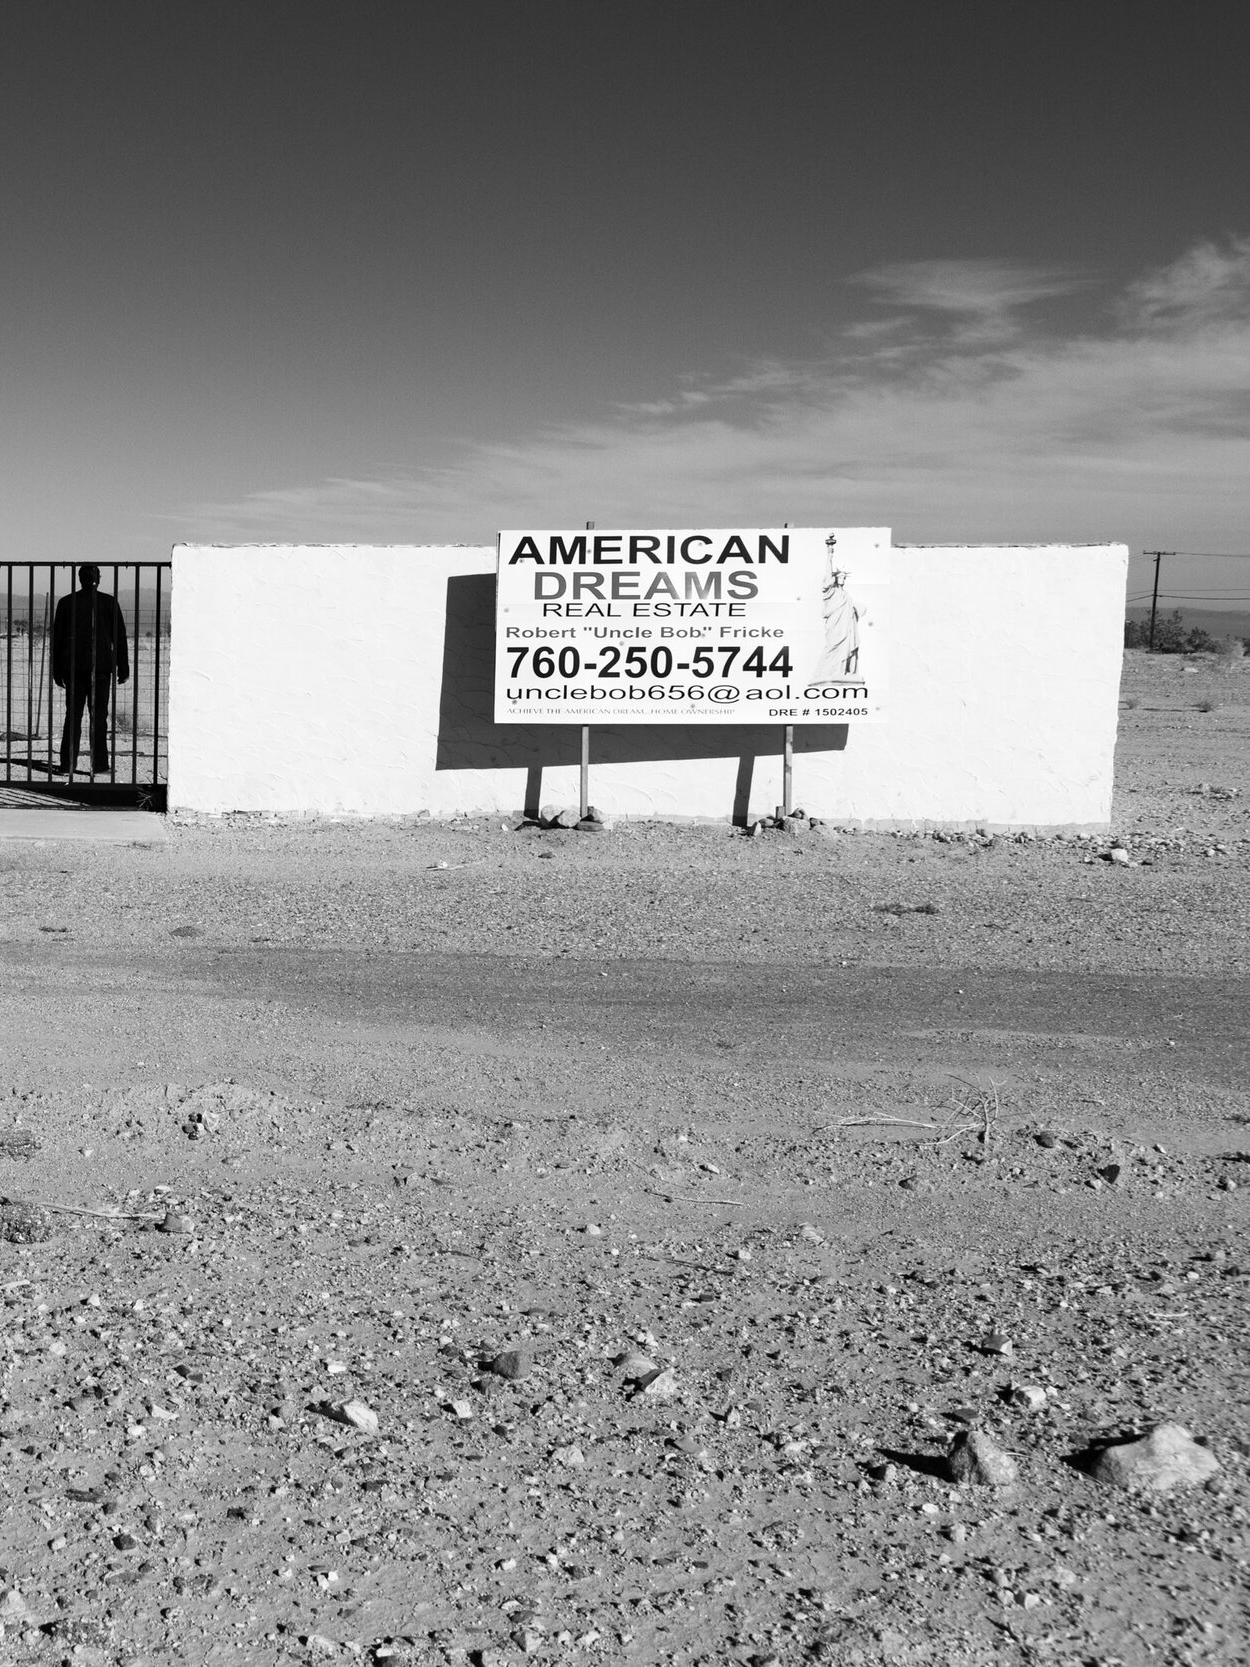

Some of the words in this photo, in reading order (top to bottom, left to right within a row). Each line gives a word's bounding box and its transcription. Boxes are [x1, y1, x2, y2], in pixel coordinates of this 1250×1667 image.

[508, 534, 790, 565] AMERICAN
[534, 571, 759, 601] DREAMS
[542, 603, 622, 618] REAL
[632, 602, 747, 617] ESTATE
[506, 626, 577, 639] Robert
[583, 626, 653, 639] "Uncle
[719, 626, 784, 638] Fricke
[506, 645, 794, 679] 760-250-5744
[506, 684, 869, 704] unclebob656@aol.com
[564, 707, 612, 715] AMERICAN
[768, 708, 798, 717] DRE
[802, 708, 810, 717] #
[814, 707, 869, 717] 1502405
